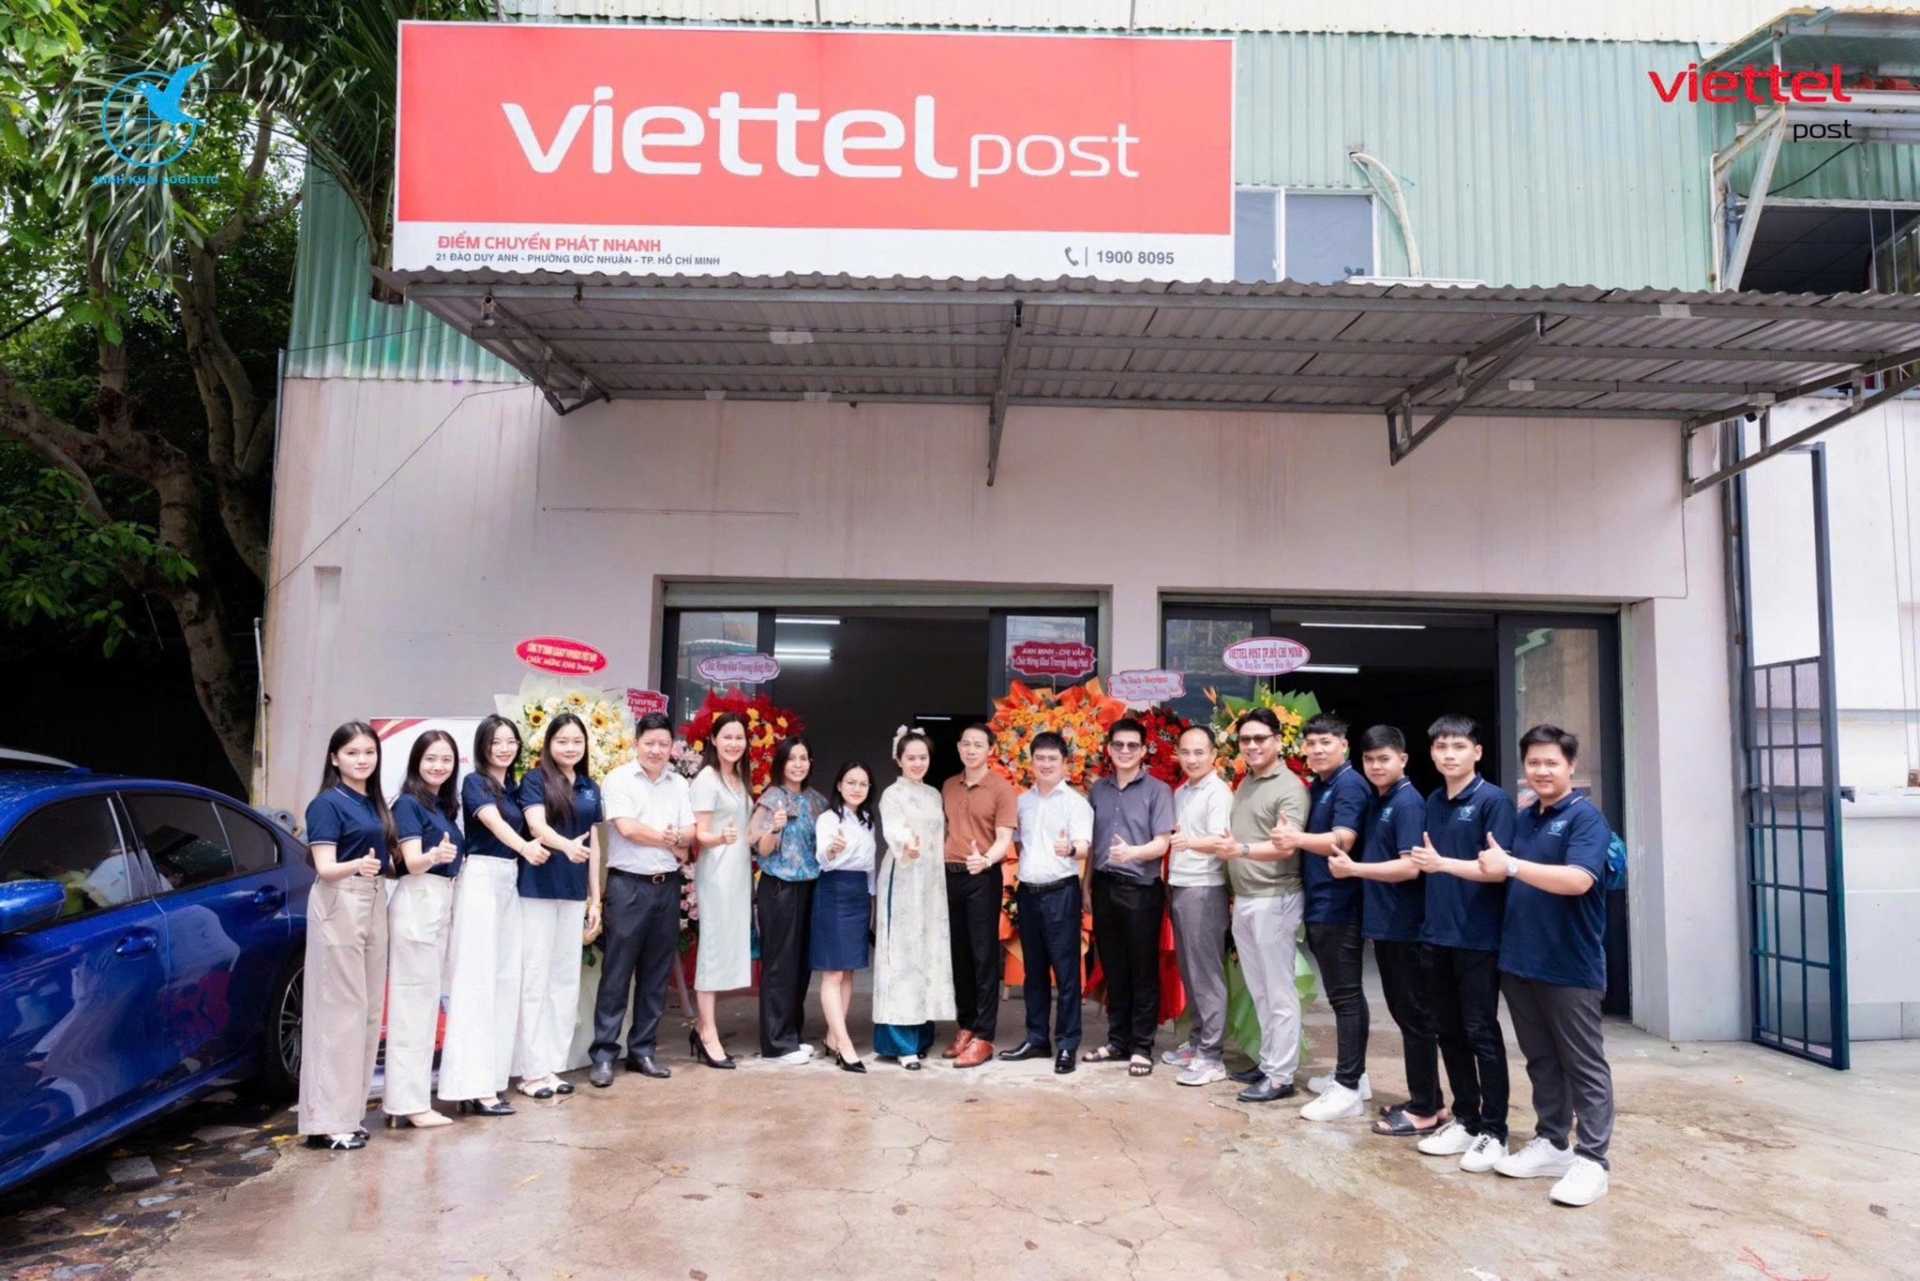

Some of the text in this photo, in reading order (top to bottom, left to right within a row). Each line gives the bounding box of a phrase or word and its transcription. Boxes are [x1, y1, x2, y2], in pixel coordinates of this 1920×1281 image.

[501, 85, 1140, 188] viettel post
[437, 231, 661, 252] ĐIỂM CHUYỂN PHÁT NHANH
[436, 252, 447, 261] 21
[450, 251, 472, 262] ĐÀO
[474, 253, 495, 262] DUY
[497, 253, 518, 263] ANH
[527, 252, 570, 264] PHƯỜNG
[573, 253, 594, 264] ĐỨC
[597, 254, 632, 266] NHUẬN
[641, 256, 655, 265] TP.
[675, 254, 692, 265] CHÍ
[695, 256, 720, 266] MINH
[1097, 250, 1175, 265] 1900 8095
[1229, 648, 1247, 659] VIETTEL
[1249, 647, 1261, 659] POST
